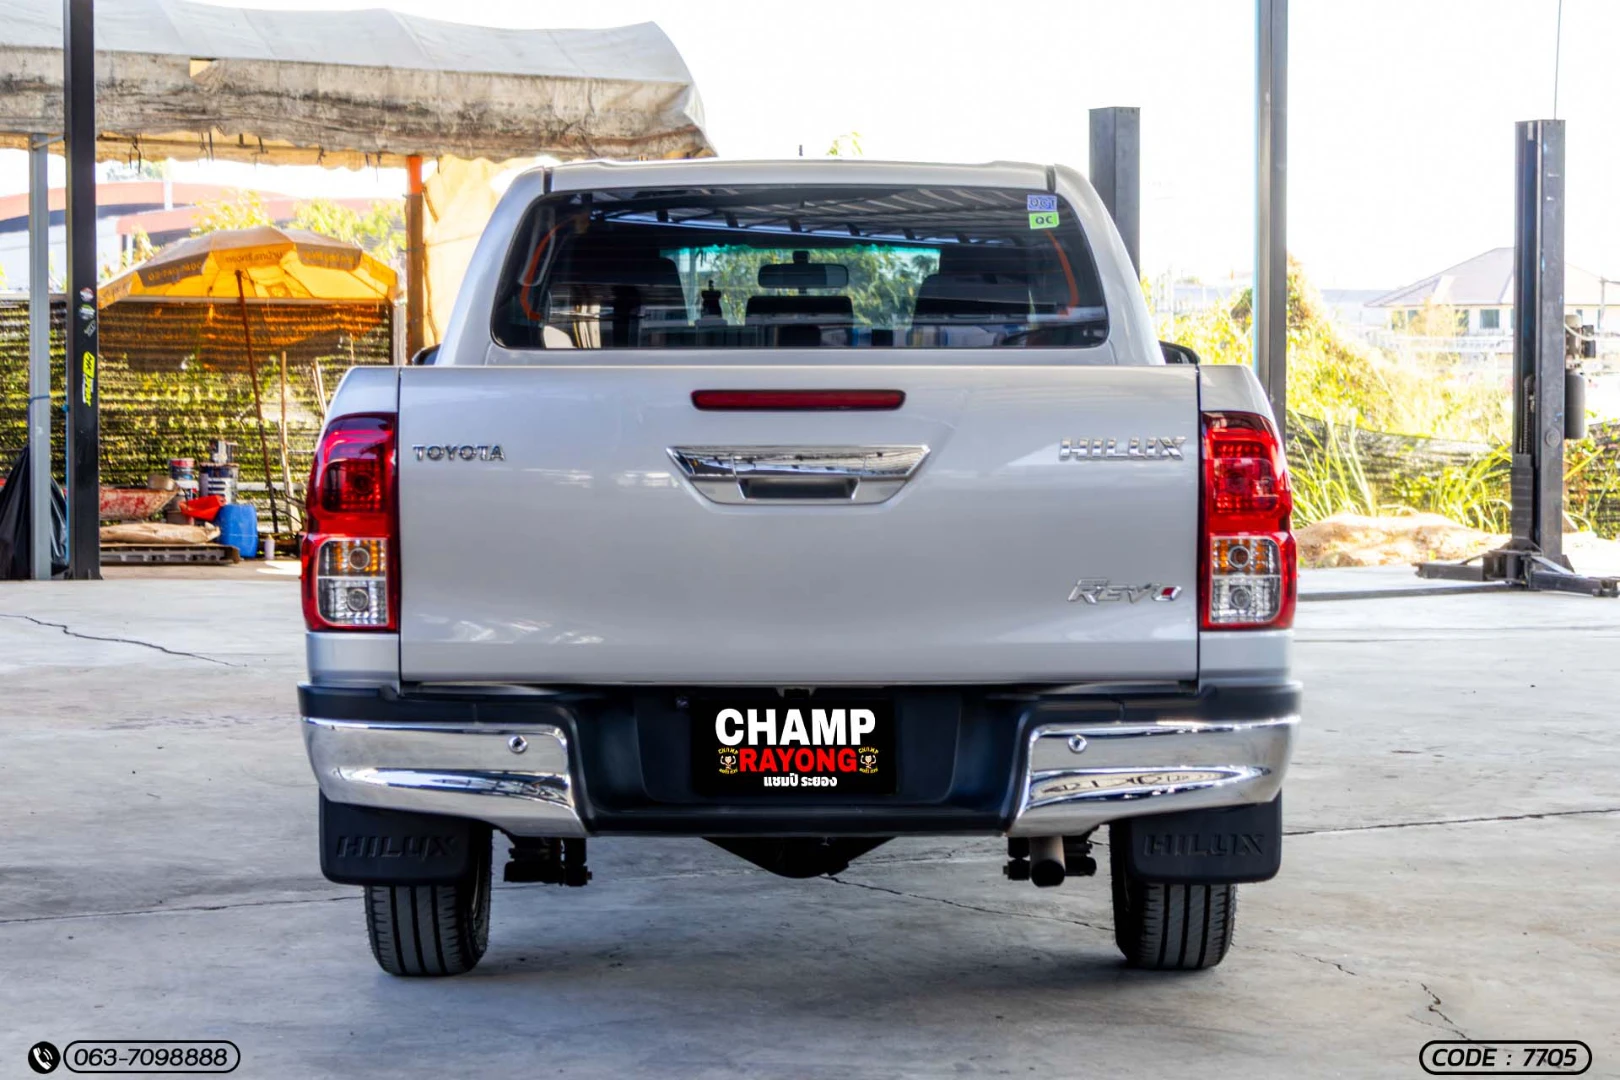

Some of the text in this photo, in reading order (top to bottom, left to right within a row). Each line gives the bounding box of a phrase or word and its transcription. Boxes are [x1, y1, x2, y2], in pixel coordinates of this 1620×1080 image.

[1035, 215, 1054, 225] QC
[412, 445, 506, 461] TOYOTA
[1060, 436, 1186, 461] HILUX
[337, 836, 459, 859] HILUX
[1143, 833, 1265, 858] HILUX
